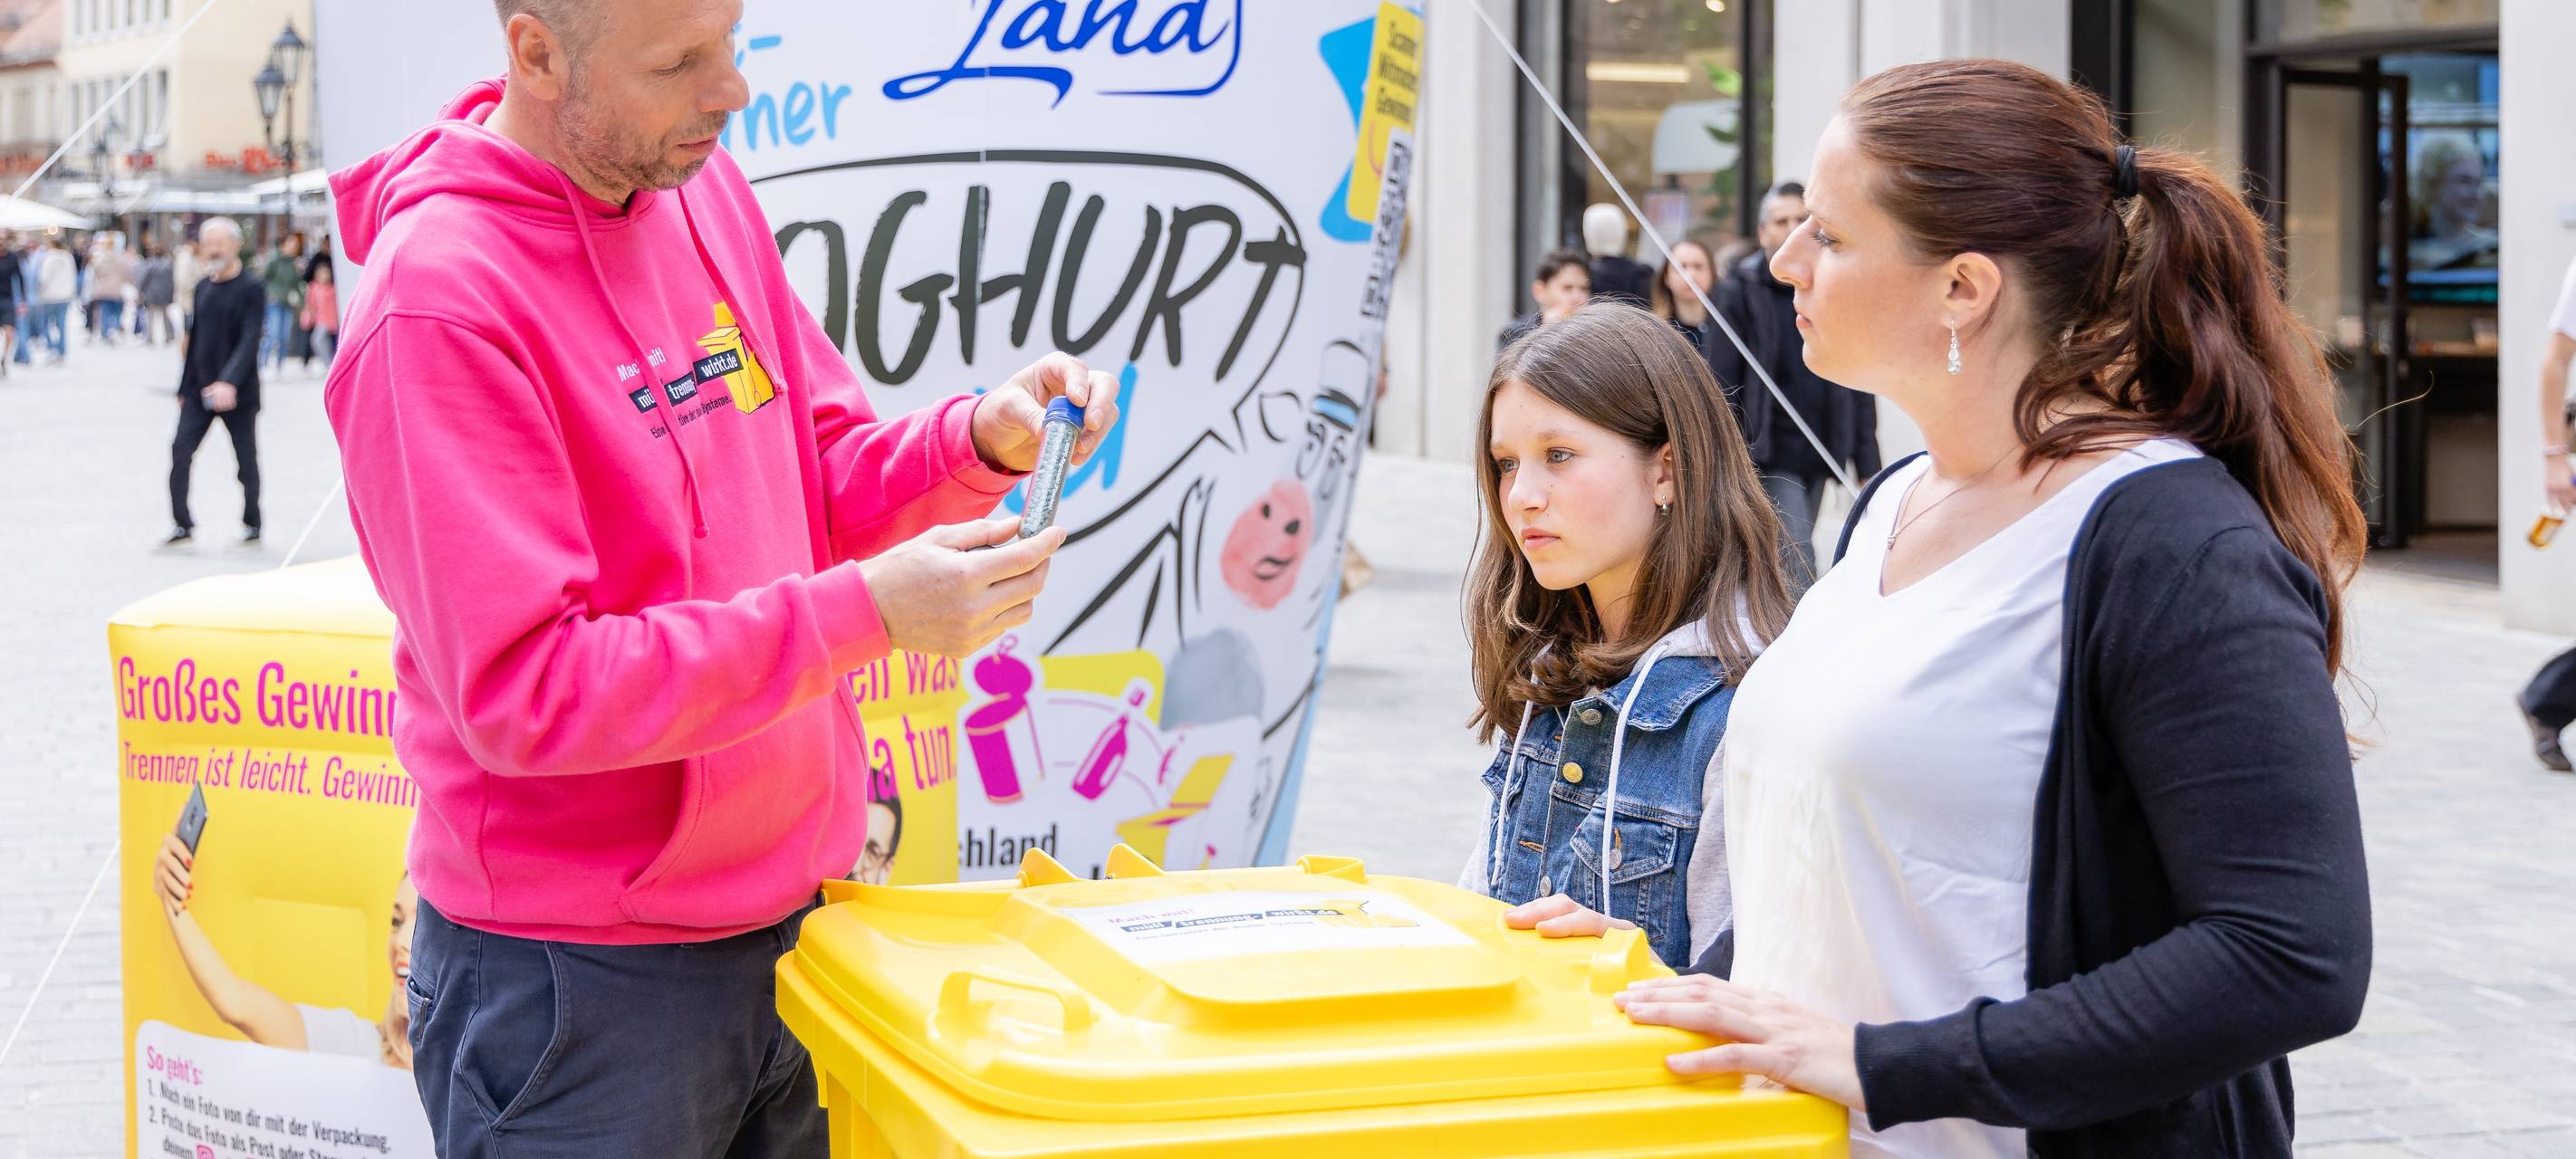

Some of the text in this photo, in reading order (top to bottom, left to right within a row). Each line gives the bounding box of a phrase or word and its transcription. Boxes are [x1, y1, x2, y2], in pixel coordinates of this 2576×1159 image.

[774, 181, 1306, 387] OGHURT
[617, 359, 640, 382] Mac
[701, 353, 738, 378] wirkt.de
[120, 656, 241, 725] Großes
[123, 741, 199, 785] Trennen
[205, 746, 234, 787] ist
[240, 748, 311, 795] leicht.
[146, 1044, 163, 1071] So
[198, 1096, 219, 1119] Foto
[224, 1107, 243, 1125] von
[245, 1107, 261, 1128] dir
[264, 1114, 284, 1134] mit
[288, 1117, 308, 1137] der
[312, 1119, 391, 1155] Verpackung.
[249, 1135, 275, 1159] Post
